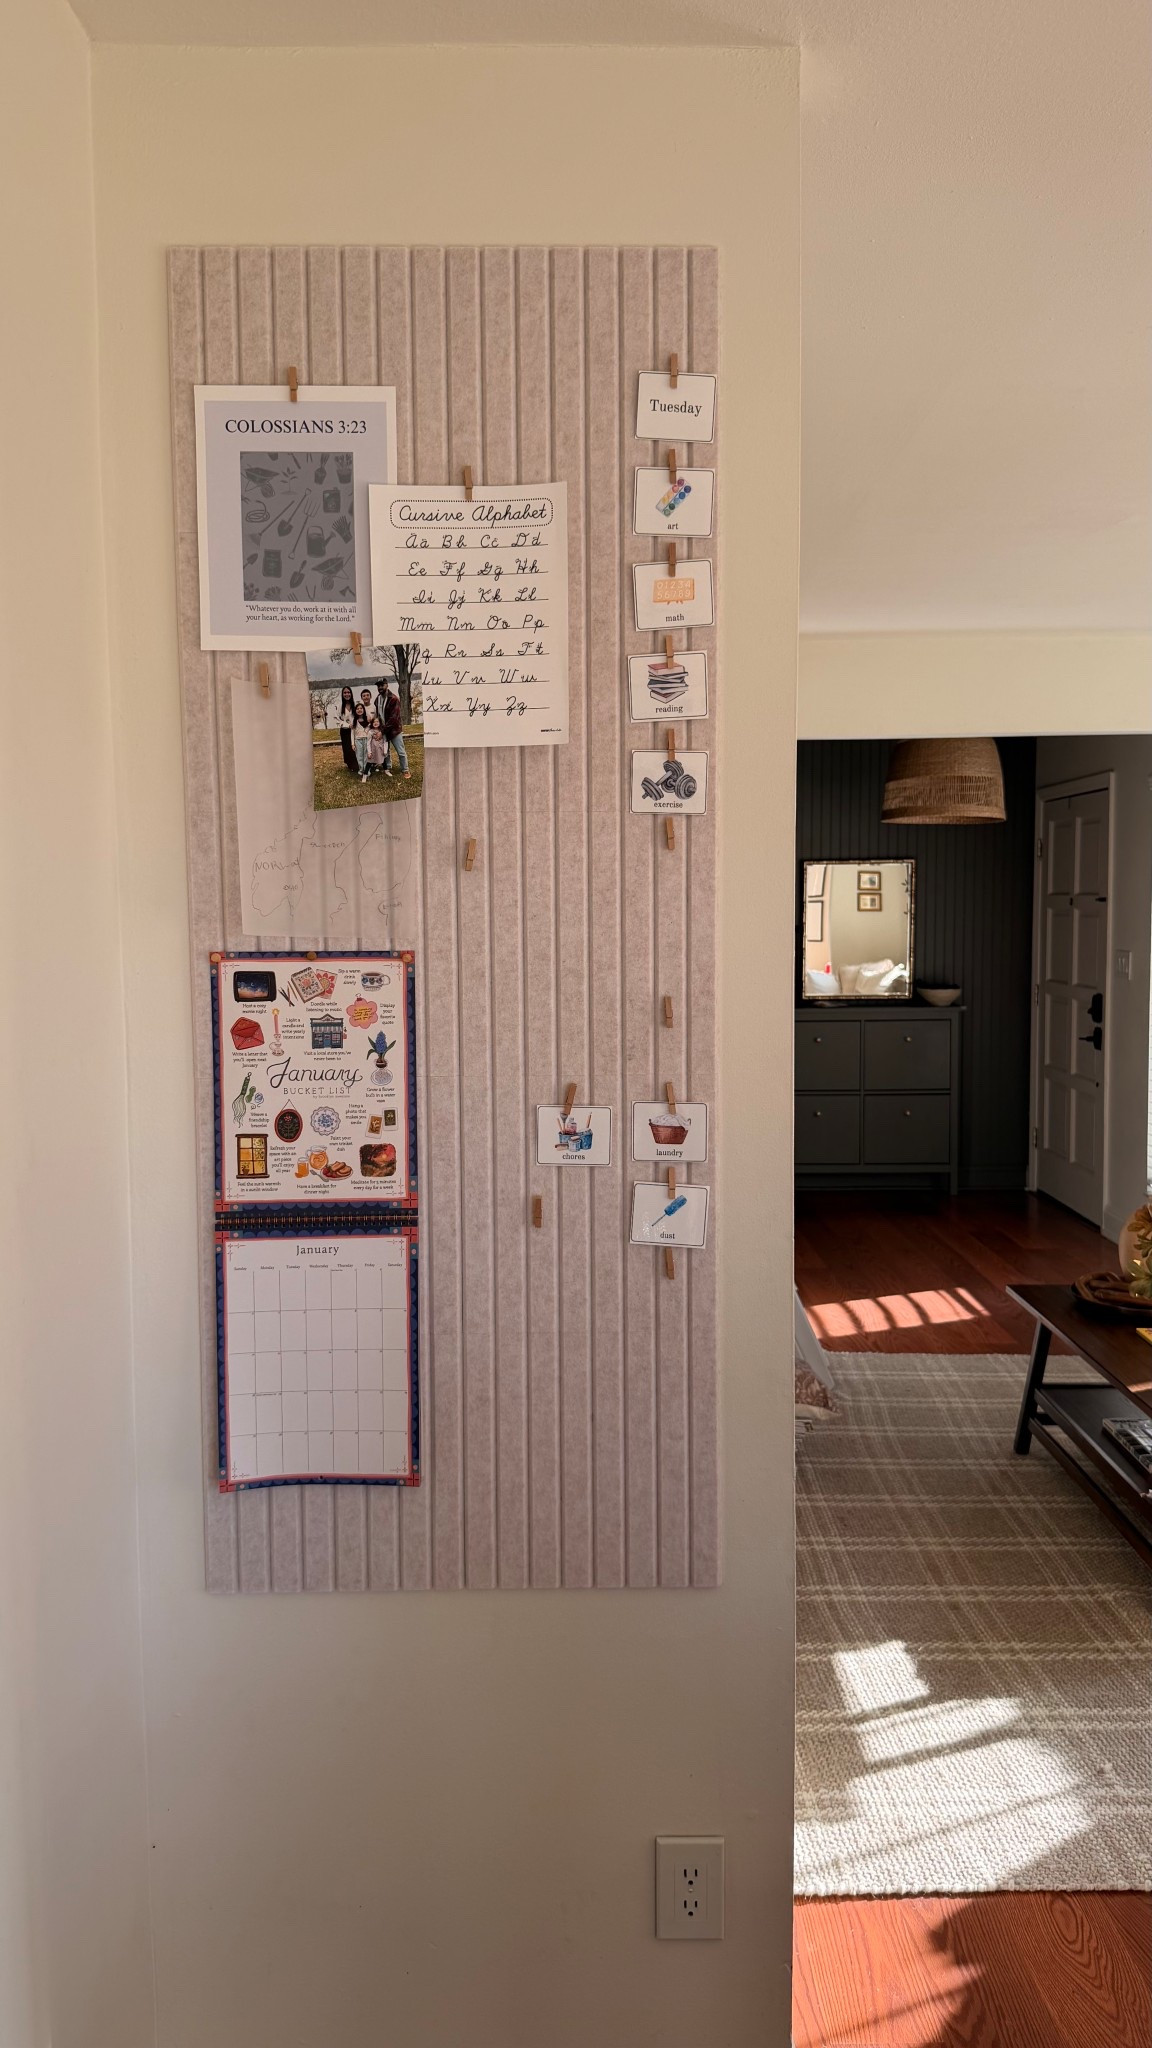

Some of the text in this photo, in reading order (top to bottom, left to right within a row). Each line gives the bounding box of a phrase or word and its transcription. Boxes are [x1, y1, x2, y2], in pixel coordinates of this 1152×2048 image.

[649, 398, 703, 418] Tuesday
[225, 419, 367, 434] COLOSSIANS 3:23
[399, 503, 547, 529] Cursive Alphabet
[405, 532, 542, 549] Aa Bb Cc Dd
[408, 561, 428, 576] Ee
[477, 561, 504, 581] Gg
[515, 557, 539, 574] Hh
[448, 589, 466, 609] Jj
[478, 587, 502, 603] Kk
[514, 587, 537, 602] Ll
[245, 604, 279, 612] "Whatever
[279, 606, 291, 614] you
[293, 605, 303, 613] do,
[246, 615, 260, 623] your
[261, 614, 280, 622] heart,
[288, 614, 314, 624] working
[315, 614, 324, 622] for
[400, 614, 545, 633] Mm Nn Oo Pp
[665, 613, 685, 622] math
[421, 648, 432, 664] q
[445, 643, 466, 658] Rr
[481, 643, 504, 657] Ss
[426, 695, 528, 717] Xx Yy Zz
[655, 704, 684, 713] reading
[654, 800, 683, 809] exercise
[266, 1056, 363, 1089] January
[283, 1087, 325, 1095] BUCKET
[562, 1152, 586, 1161] chores
[655, 1148, 683, 1158] laundry
[659, 1232, 676, 1240] dust
[296, 1245, 339, 1256] January
